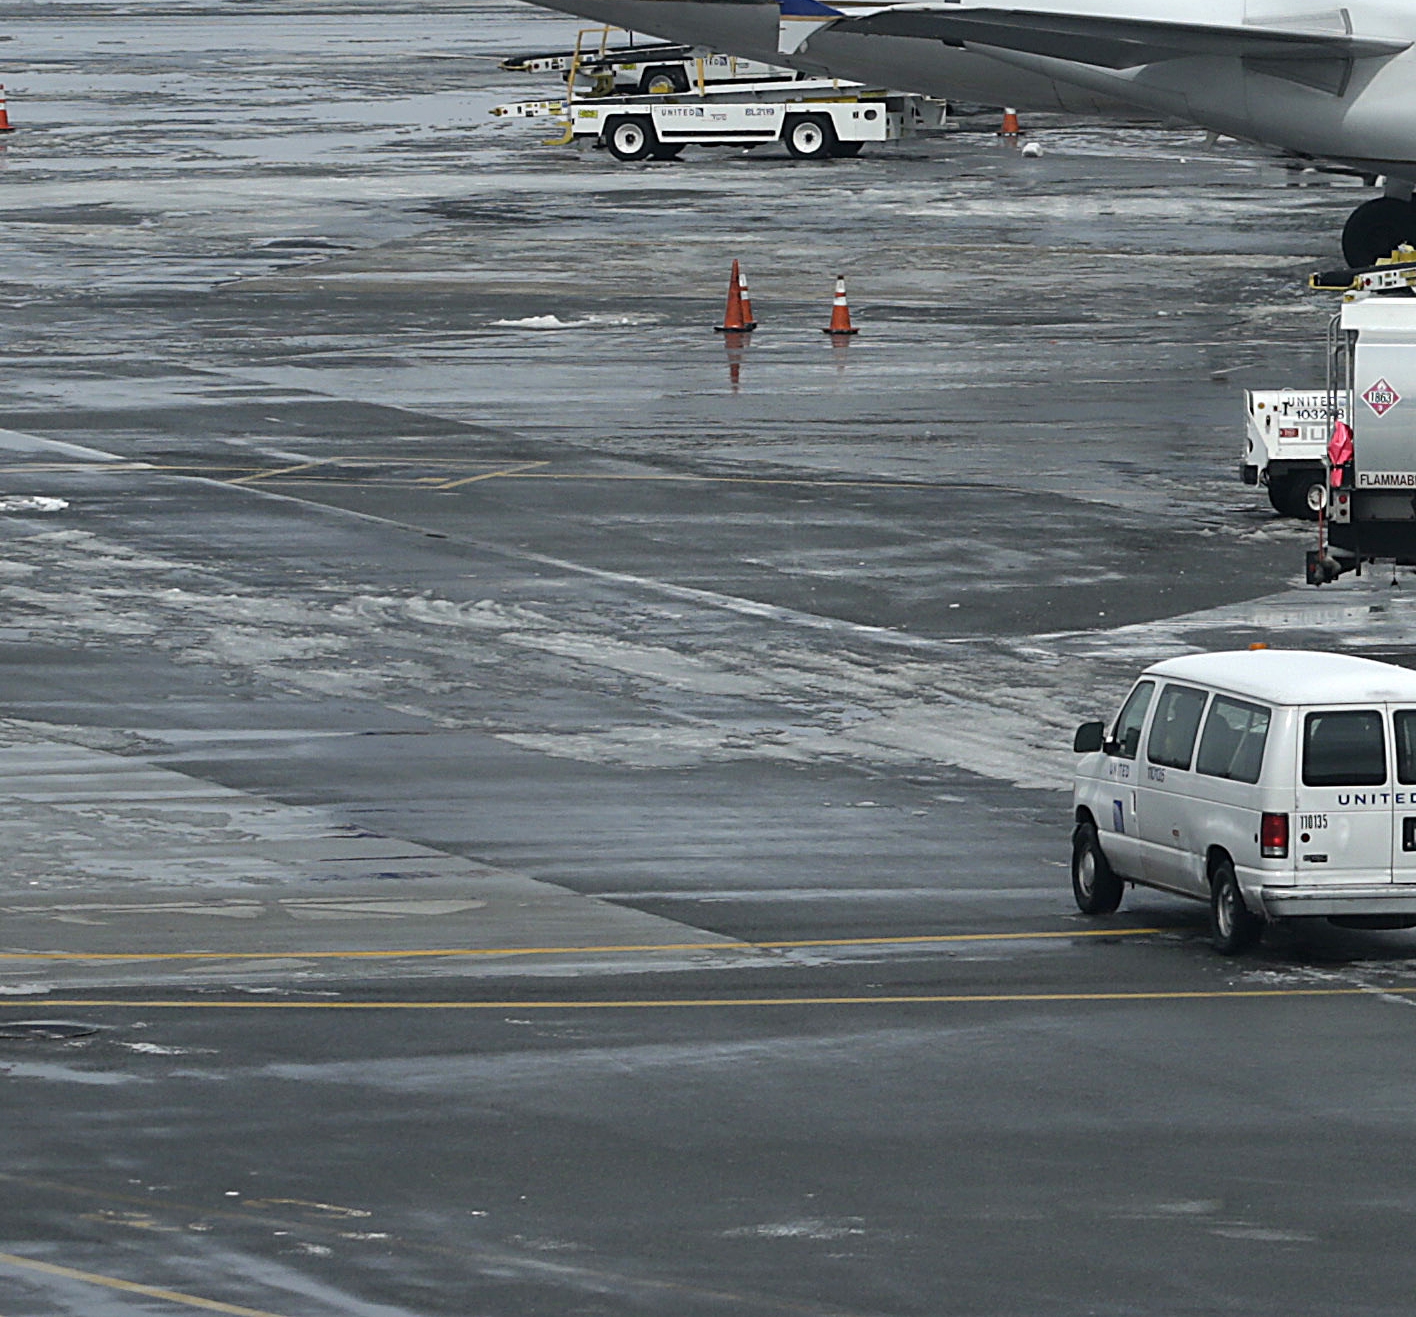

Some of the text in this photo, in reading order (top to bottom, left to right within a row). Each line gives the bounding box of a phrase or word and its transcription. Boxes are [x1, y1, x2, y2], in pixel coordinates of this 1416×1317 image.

[661, 108, 695, 116] UNITED
[1371, 391, 1392, 403] 1863
[1300, 814, 1328, 829] 110135
